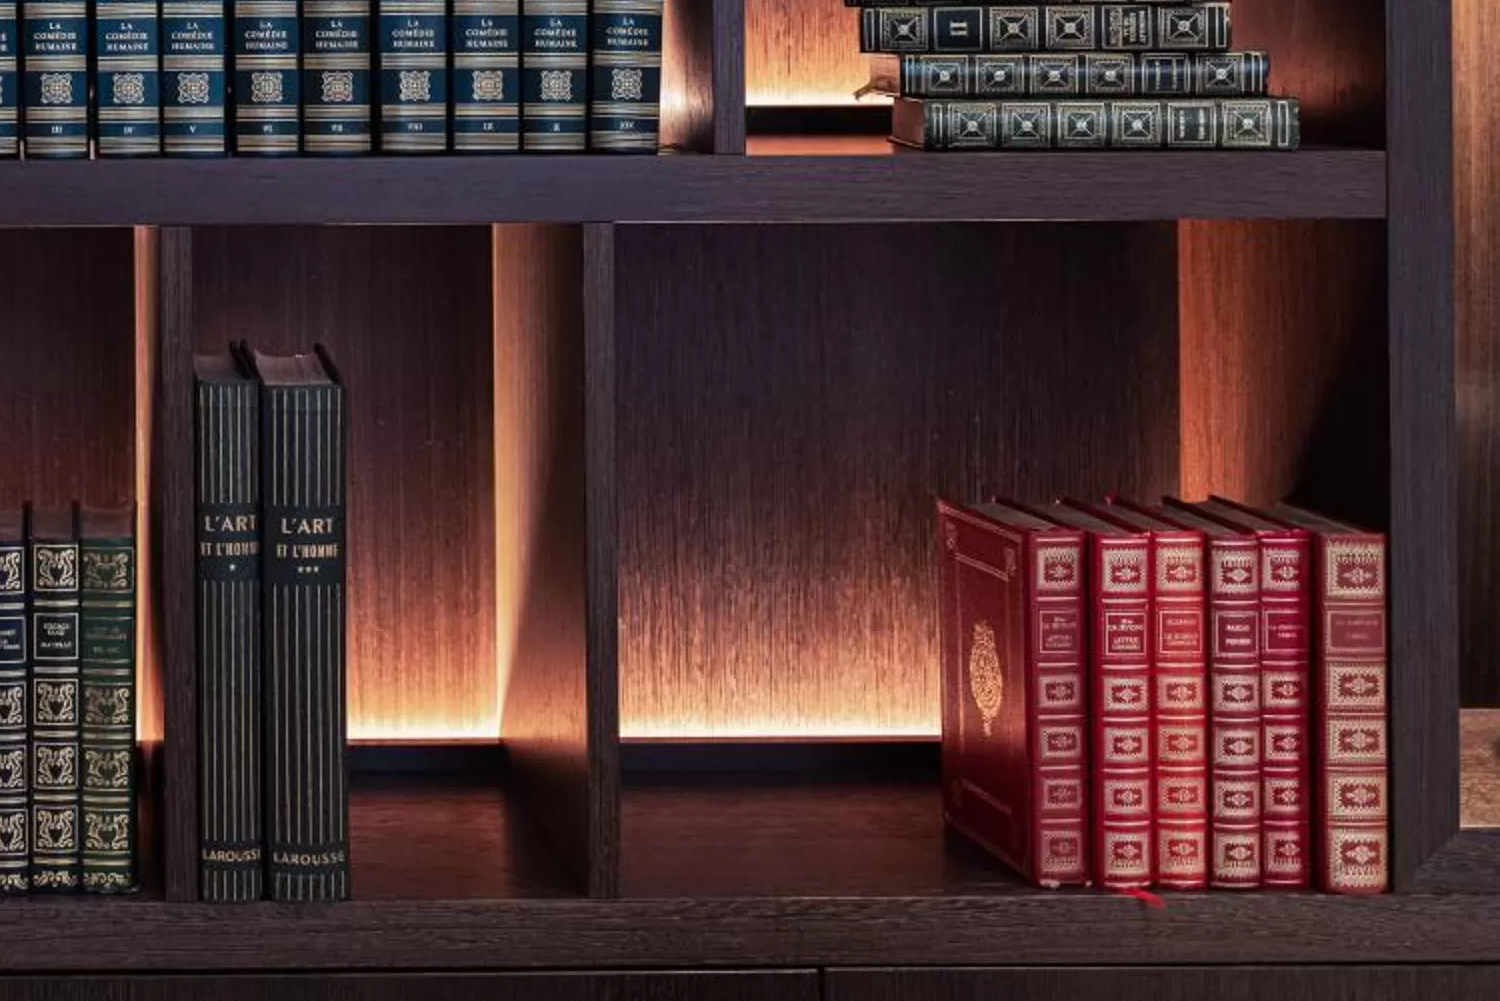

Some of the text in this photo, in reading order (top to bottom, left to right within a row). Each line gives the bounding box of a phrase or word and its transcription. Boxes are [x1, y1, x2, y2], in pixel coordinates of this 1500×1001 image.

[49, 22, 61, 30] LA
[186, 22, 199, 30] LA
[259, 21, 273, 29] LA
[330, 20, 343, 28] LA
[407, 19, 419, 28] LA
[481, 19, 493, 27] LA
[549, 19, 562, 27] LA
[622, 17, 636, 25] LA
[120, 22, 133, 31] LA
[606, 26, 649, 36] COMÉDIE
[34, 30, 77, 41] COMÉDIE
[105, 30, 148, 41] COMÉDIE
[171, 30, 213, 40] COMÉDIE
[244, 29, 288, 40] COMÉDIE
[315, 28, 357, 38] COMÉDIE
[391, 28, 435, 38] COMÉDIE
[465, 27, 508, 37] COMÉDIE
[534, 27, 577, 37] COMÉDIE
[204, 514, 257, 532] L'ART
[281, 517, 333, 534] L'ART
[216, 541, 260, 556] L'HOMM
[276, 543, 339, 558] ET L'HOMME
[273, 850, 345, 866] LAROUSSE
